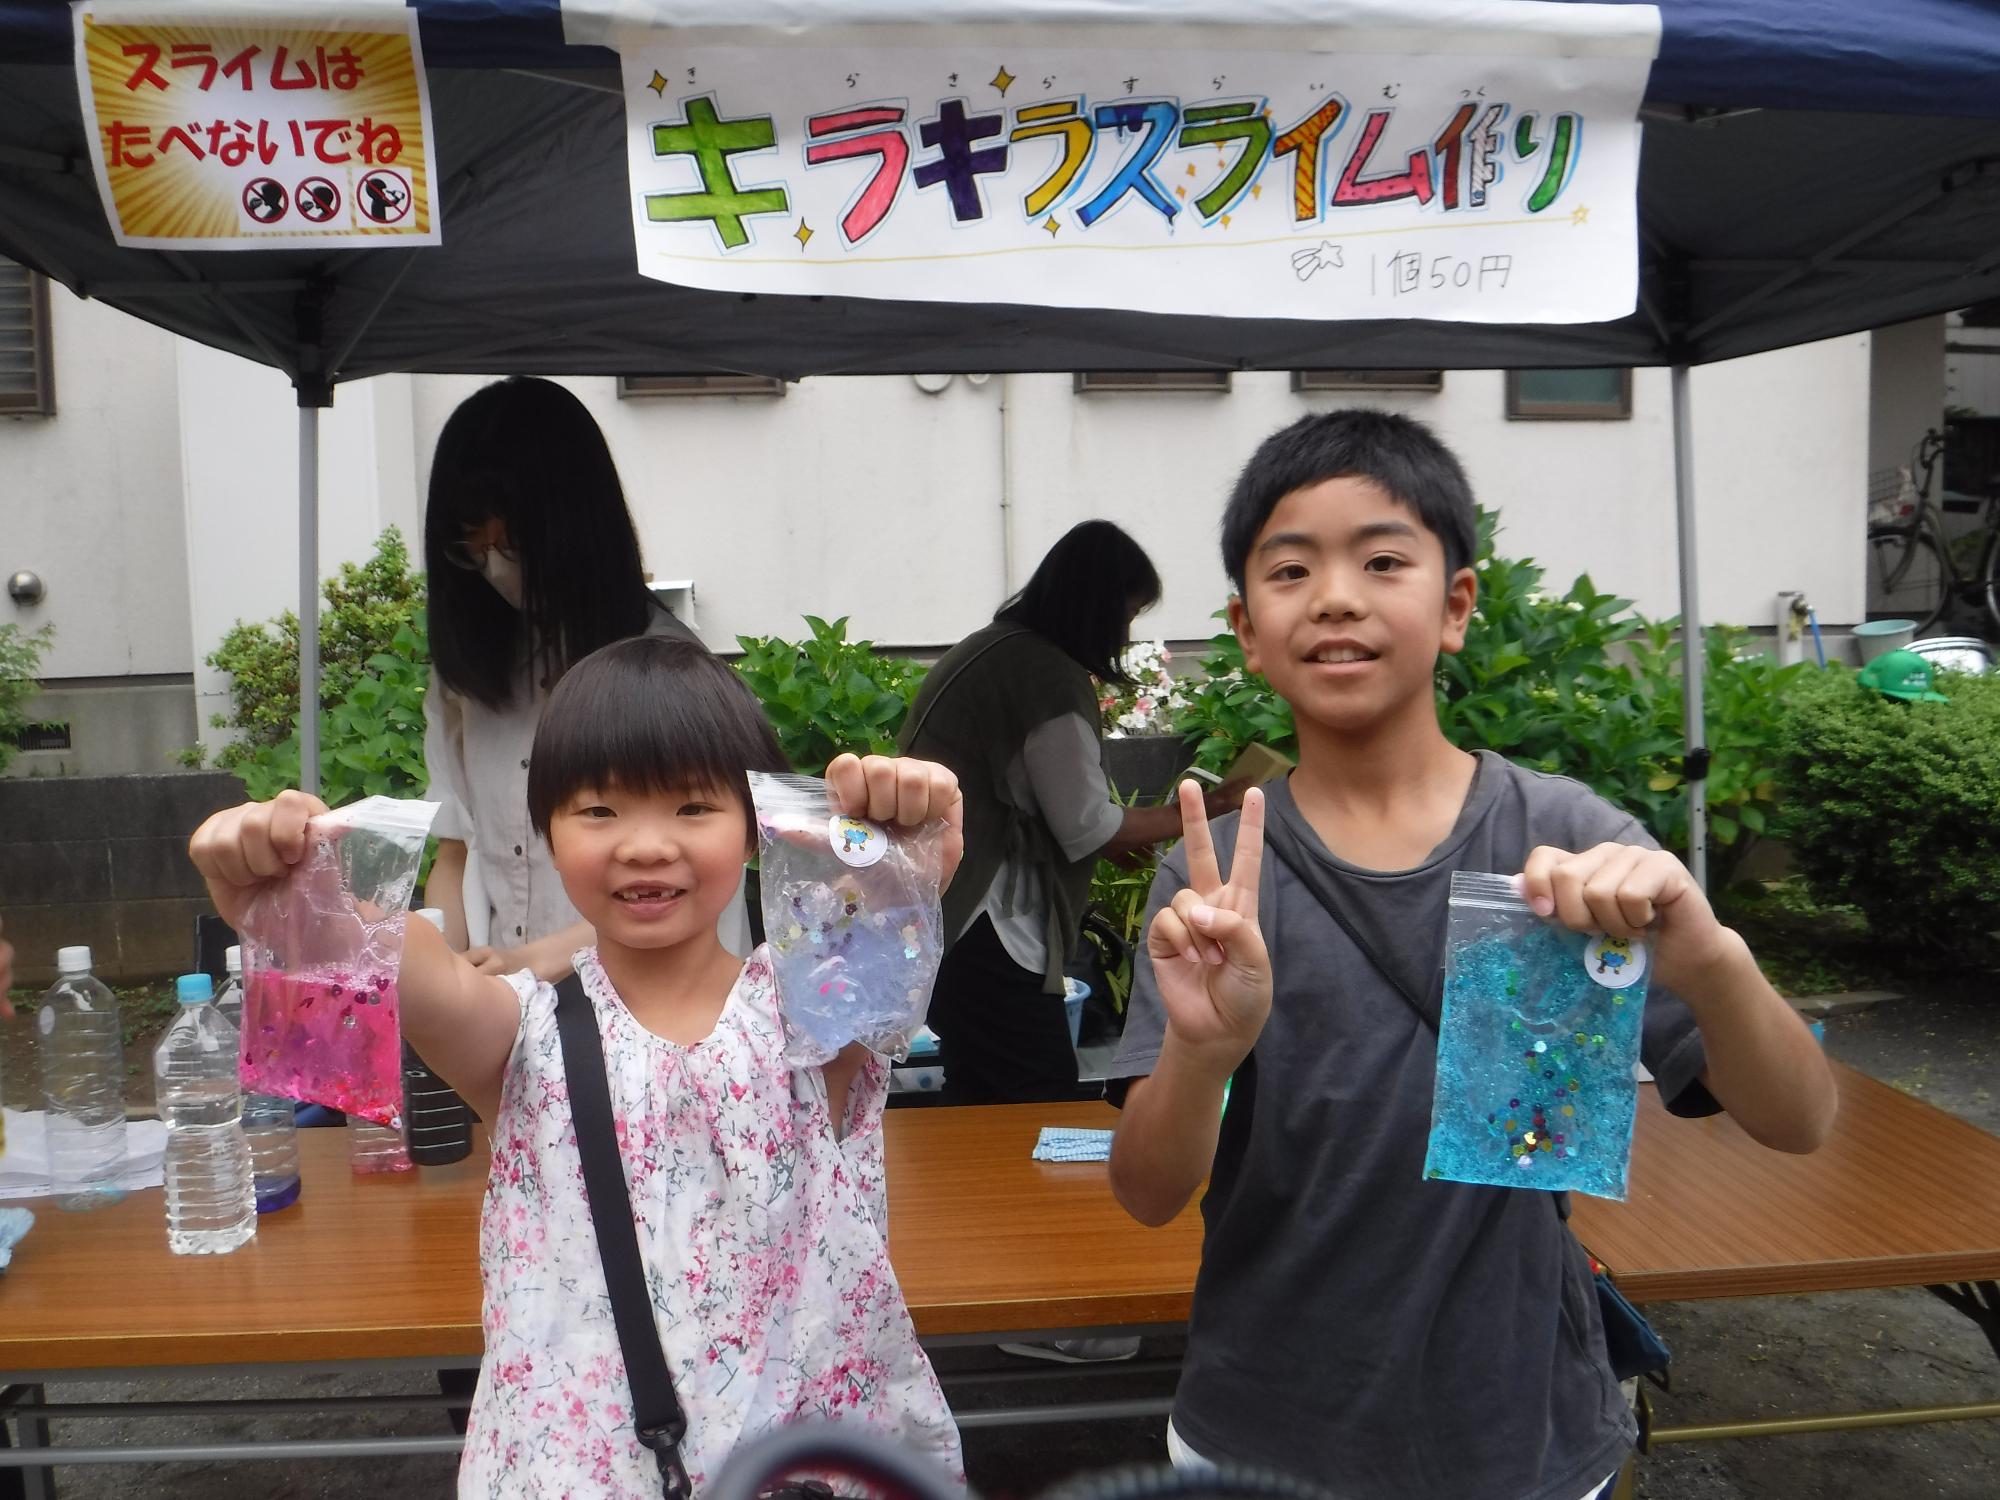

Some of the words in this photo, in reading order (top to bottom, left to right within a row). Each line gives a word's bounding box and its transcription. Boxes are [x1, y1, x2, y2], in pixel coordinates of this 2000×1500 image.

[121, 43, 365, 92] スライムは
[104, 116, 403, 168] たべないでね
[642, 94, 1580, 250] キラキラスライム作り
